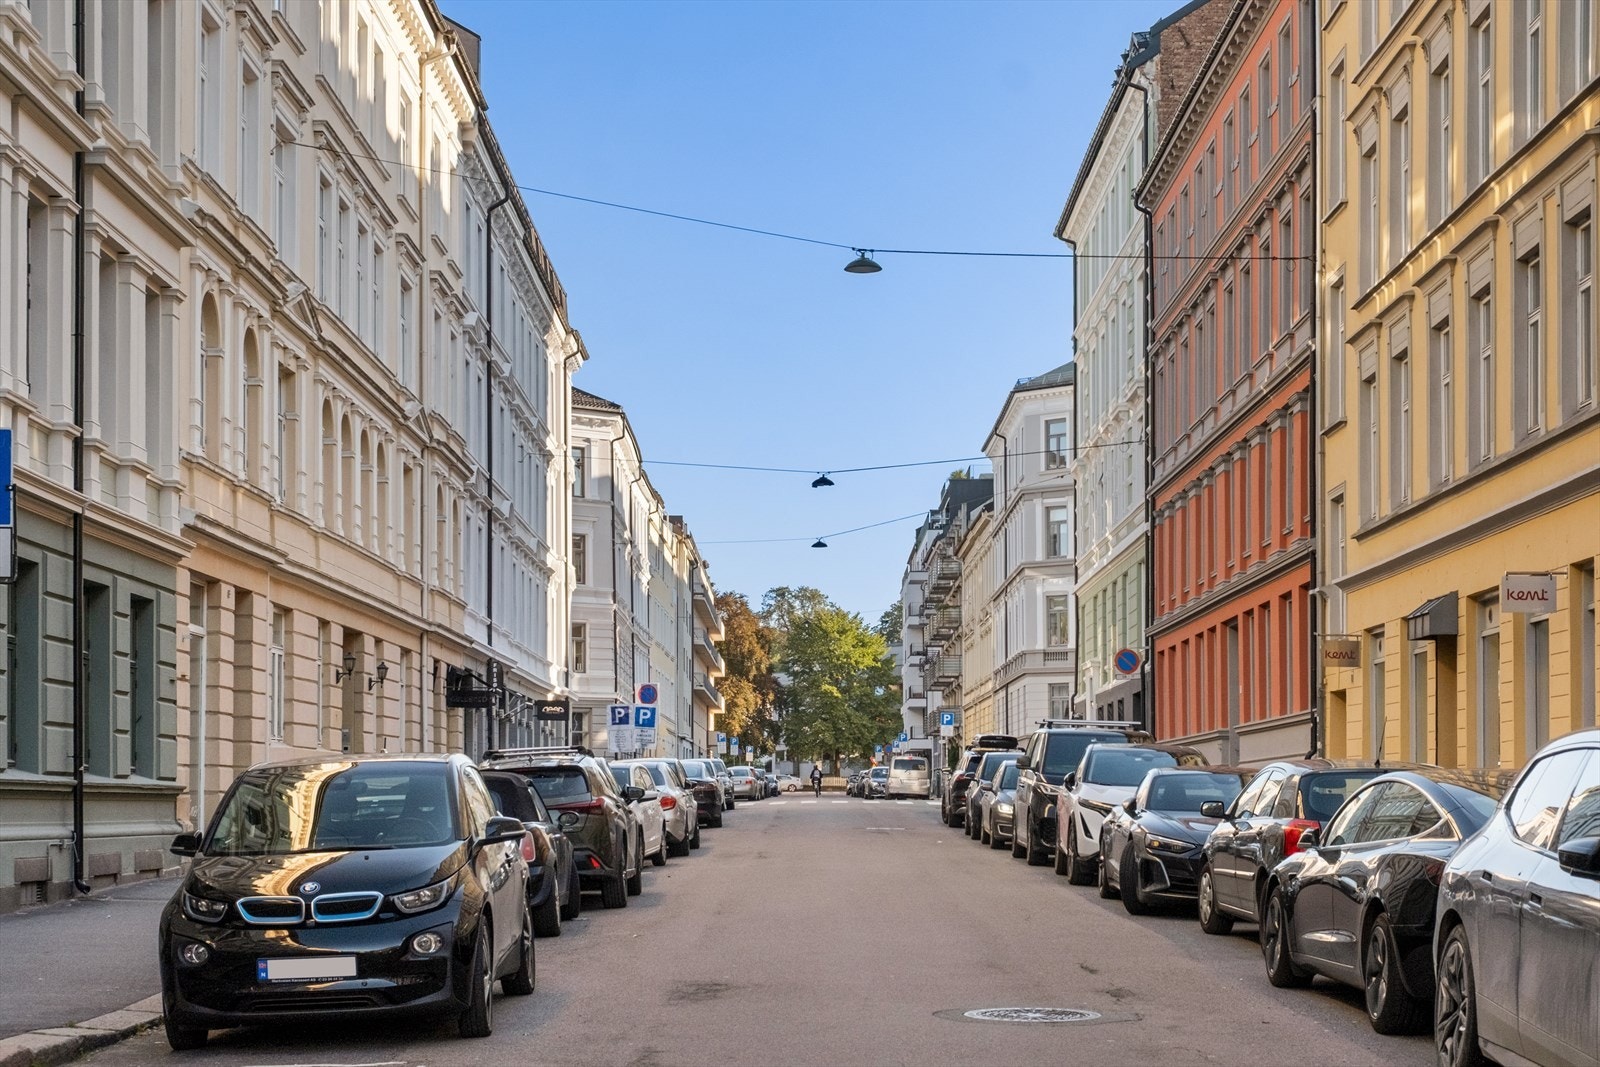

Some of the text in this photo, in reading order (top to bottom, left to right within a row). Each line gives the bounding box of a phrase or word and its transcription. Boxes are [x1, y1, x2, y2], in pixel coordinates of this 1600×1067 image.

[614, 708, 625, 723] P
[639, 709, 651, 725] P
[943, 714, 951, 724] P
